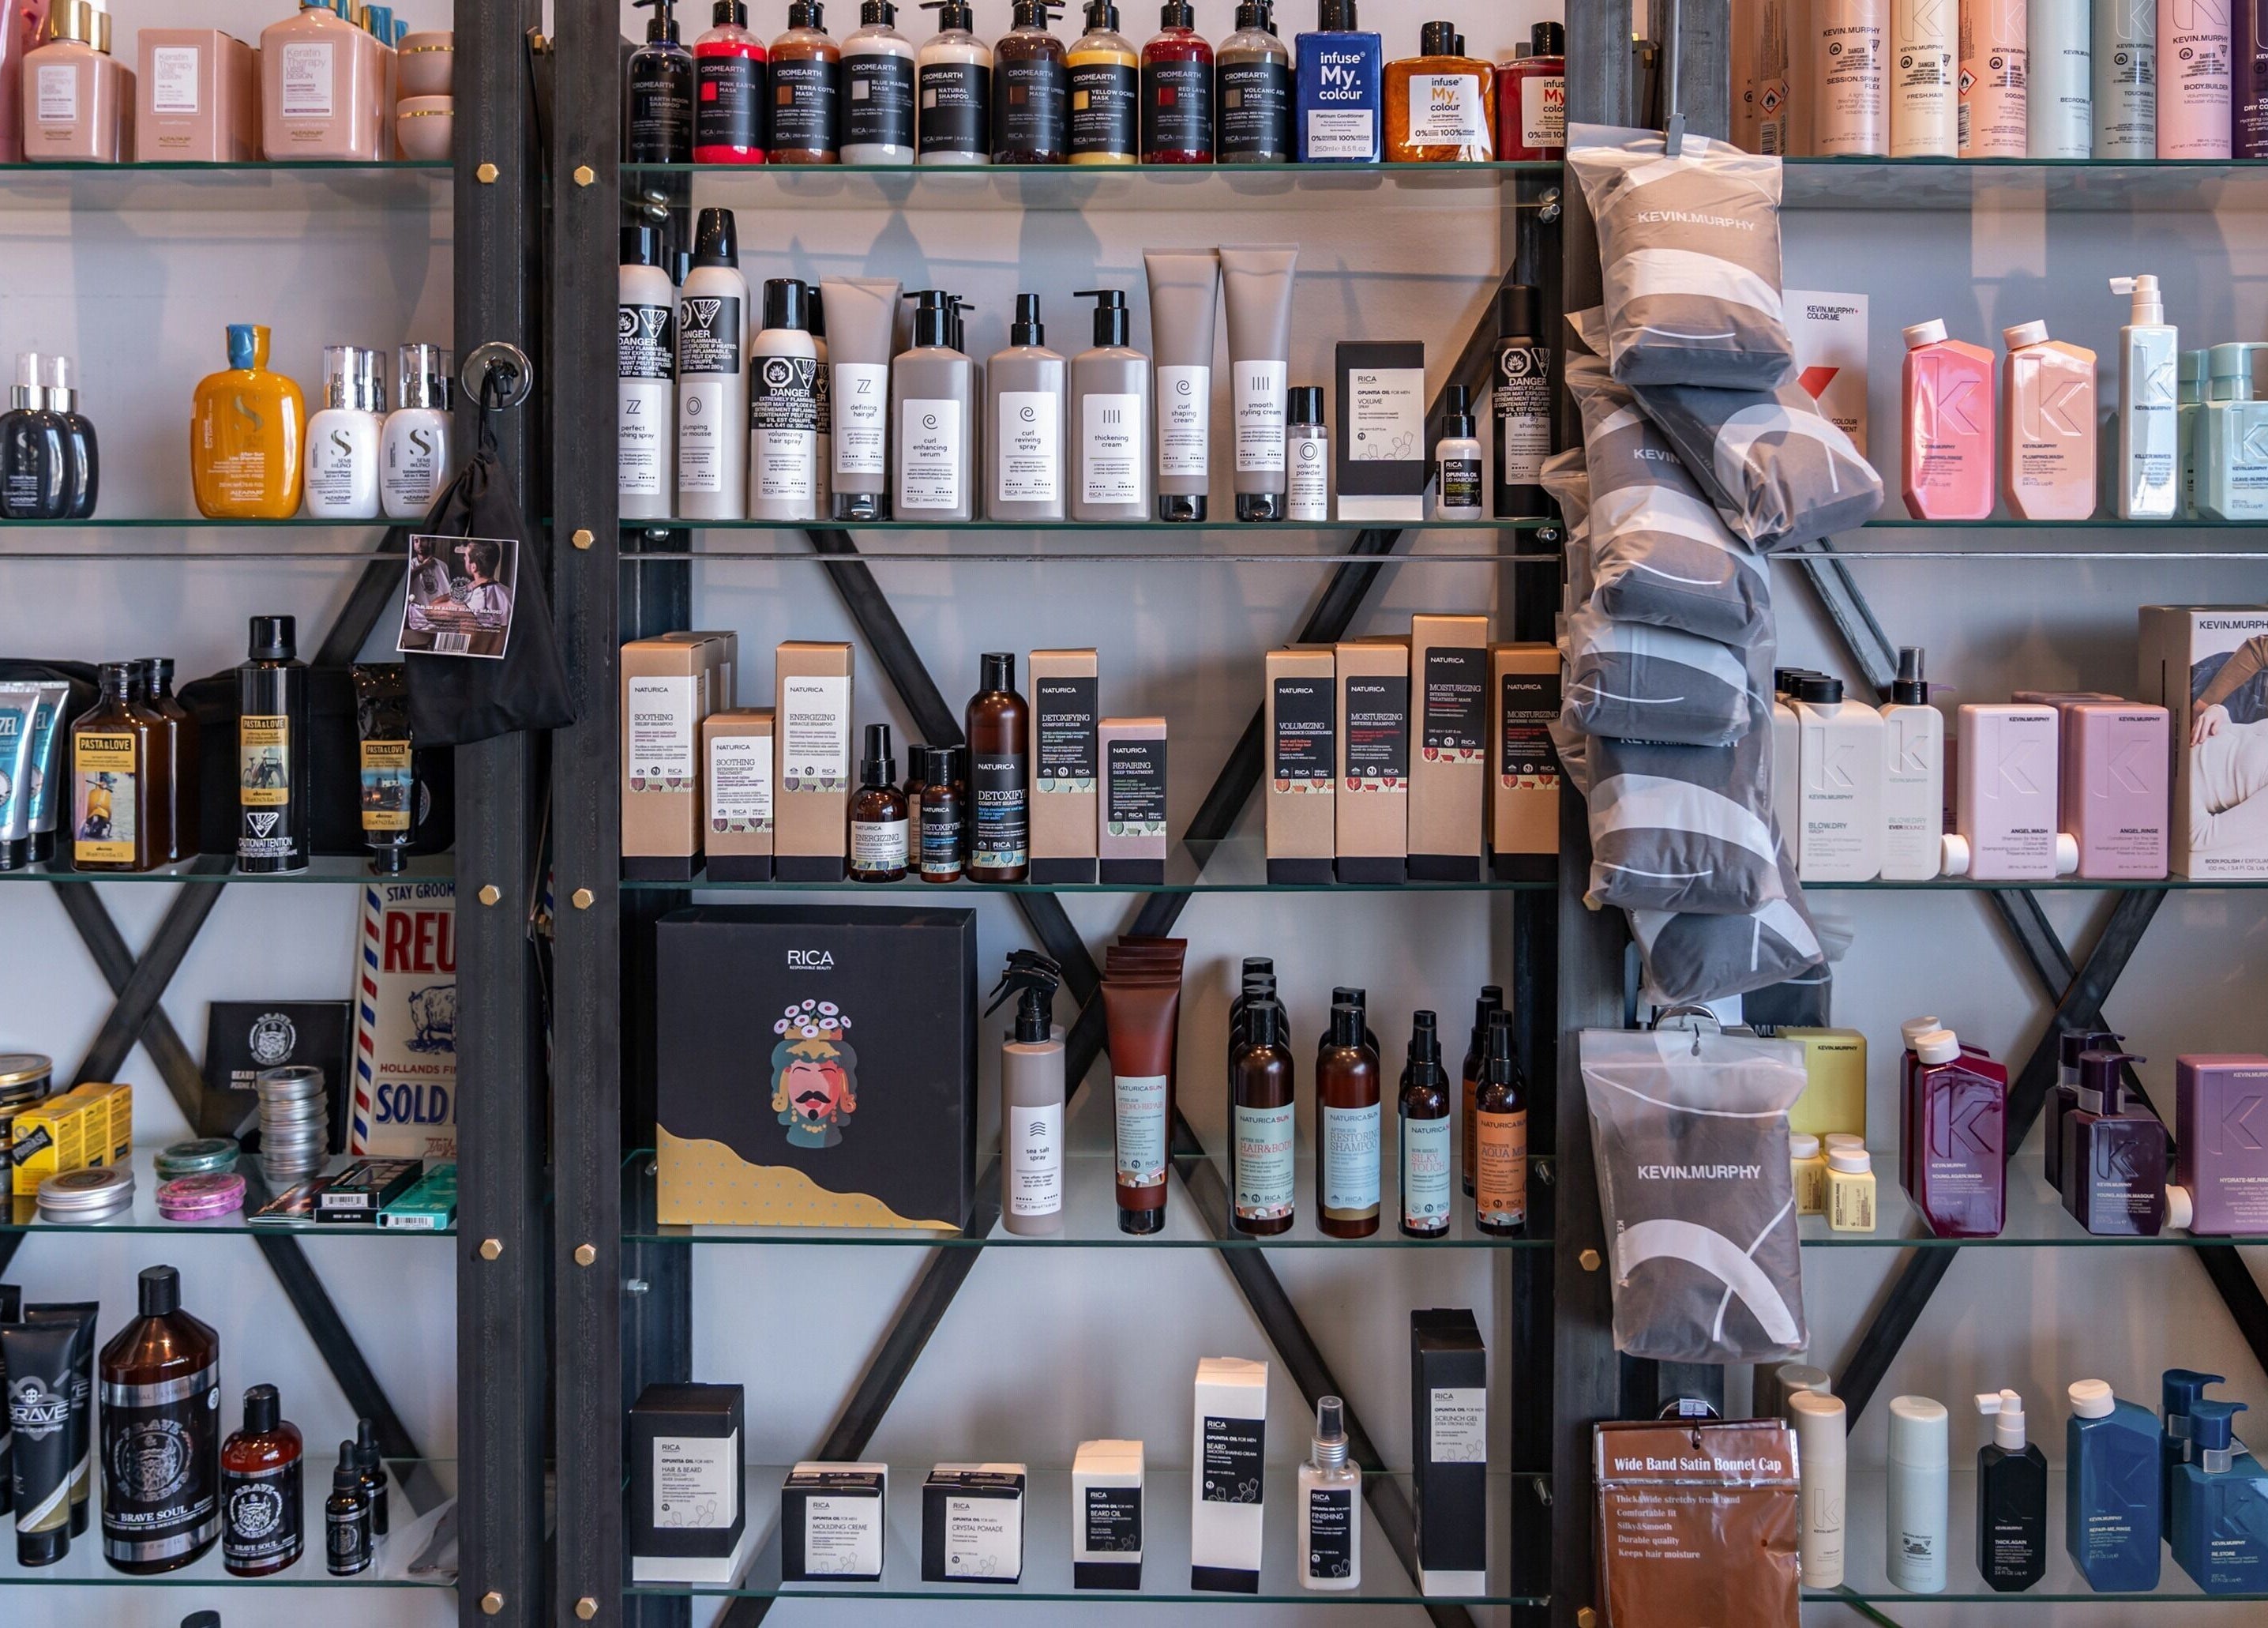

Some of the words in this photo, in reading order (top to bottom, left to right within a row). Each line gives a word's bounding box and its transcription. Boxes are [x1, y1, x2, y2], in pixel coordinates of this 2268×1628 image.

[1823, 27, 1880, 37] KEVIN.MURPHY
[2173, 35, 2229, 44] KEVIN.MURPHY
[159, 53, 189, 62] Keratin
[287, 48, 321, 58] Keratin
[287, 58, 326, 69] Therapy
[852, 63, 897, 72] CROMEARTH
[1073, 73, 1117, 82] CROMEARTH
[1157, 71, 1202, 80] CROMEARTH
[1225, 72, 1269, 81] CROMEARTH
[1319, 89, 1363, 100] colour
[1430, 103, 1460, 111] colour
[1638, 210, 1755, 230] KEVIN.MURPHY
[1807, 312, 1840, 321] COLOR.ME
[771, 388, 809, 397] DANGER
[1095, 434, 1128, 443] thickening
[913, 444, 948, 453] enhancing
[1429, 684, 1481, 693] MOISTURIZING
[243, 720, 285, 729] PASTA&LOVE
[81, 739, 130, 750] PASTA&LOVE
[855, 833, 899, 842] ENERGIZING
[387, 885, 411, 902] STAY
[787, 950, 835, 965] RICA
[380, 1064, 439, 1074] HOLLANDS
[376, 1084, 449, 1124] SOLD
[1240, 1115, 1290, 1123] NATURICASUN
[1330, 1130, 1380, 1142] RESTORING
[1240, 1140, 1293, 1153] HAIR&BODY
[1481, 1148, 1509, 1158] AQUA
[1411, 1154, 1438, 1164] SILKY
[1411, 1163, 1445, 1172] TOUCH
[1638, 1165, 1762, 1180] KEVIN.MURPHY
[9, 1406, 69, 1422] BRAVE
[1615, 1458, 1643, 1471] Wide
[1647, 1458, 1677, 1471] Band
[1680, 1457, 1710, 1471] Satin
[1714, 1457, 1755, 1471] Bonnet
[1759, 1457, 1782, 1473] Cap
[1664, 1496, 1696, 1505] stretchy
[1721, 1495, 1740, 1504] band
[120, 1512, 154, 1522] BRAVE
[157, 1506, 188, 1520] SOUL
[1617, 1509, 1665, 1517] Comfortable
[1617, 1522, 1673, 1532] Silky&Smooth
[258, 1541, 278, 1550] SOUL
[1618, 1535, 1650, 1544] Durable
[1652, 1537, 1680, 1546] quality
[1618, 1549, 1643, 1558] Keeps
[1664, 1551, 1701, 1559] moisture
